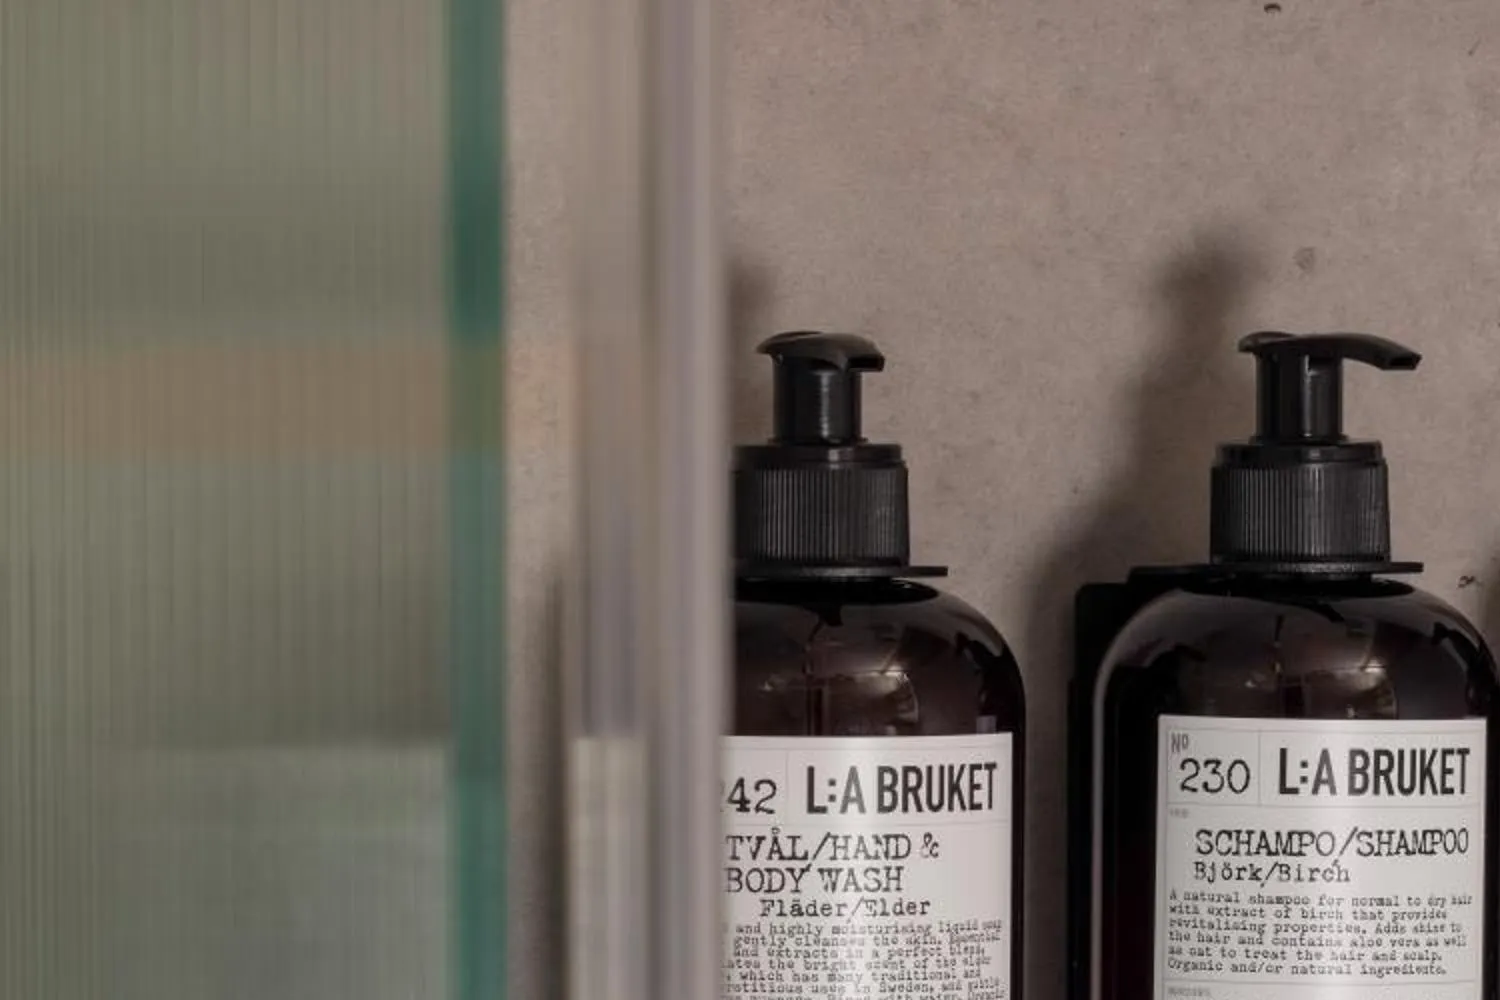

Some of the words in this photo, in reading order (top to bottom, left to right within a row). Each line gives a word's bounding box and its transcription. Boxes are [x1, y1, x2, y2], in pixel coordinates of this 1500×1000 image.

[807, 766, 866, 814] L:A
[877, 762, 997, 813] BRUKET
[1180, 758, 1250, 794] 230
[1279, 748, 1336, 795] L:A
[1348, 748, 1470, 795] BRUKET
[721, 777, 776, 814] 42
[726, 828, 911, 861] TVÅL/HAND
[920, 832, 939, 859] &
[1196, 826, 1469, 859] SCHAMPO/SHAMPOO
[725, 864, 810, 893] BODY
[818, 866, 904, 892] WASH
